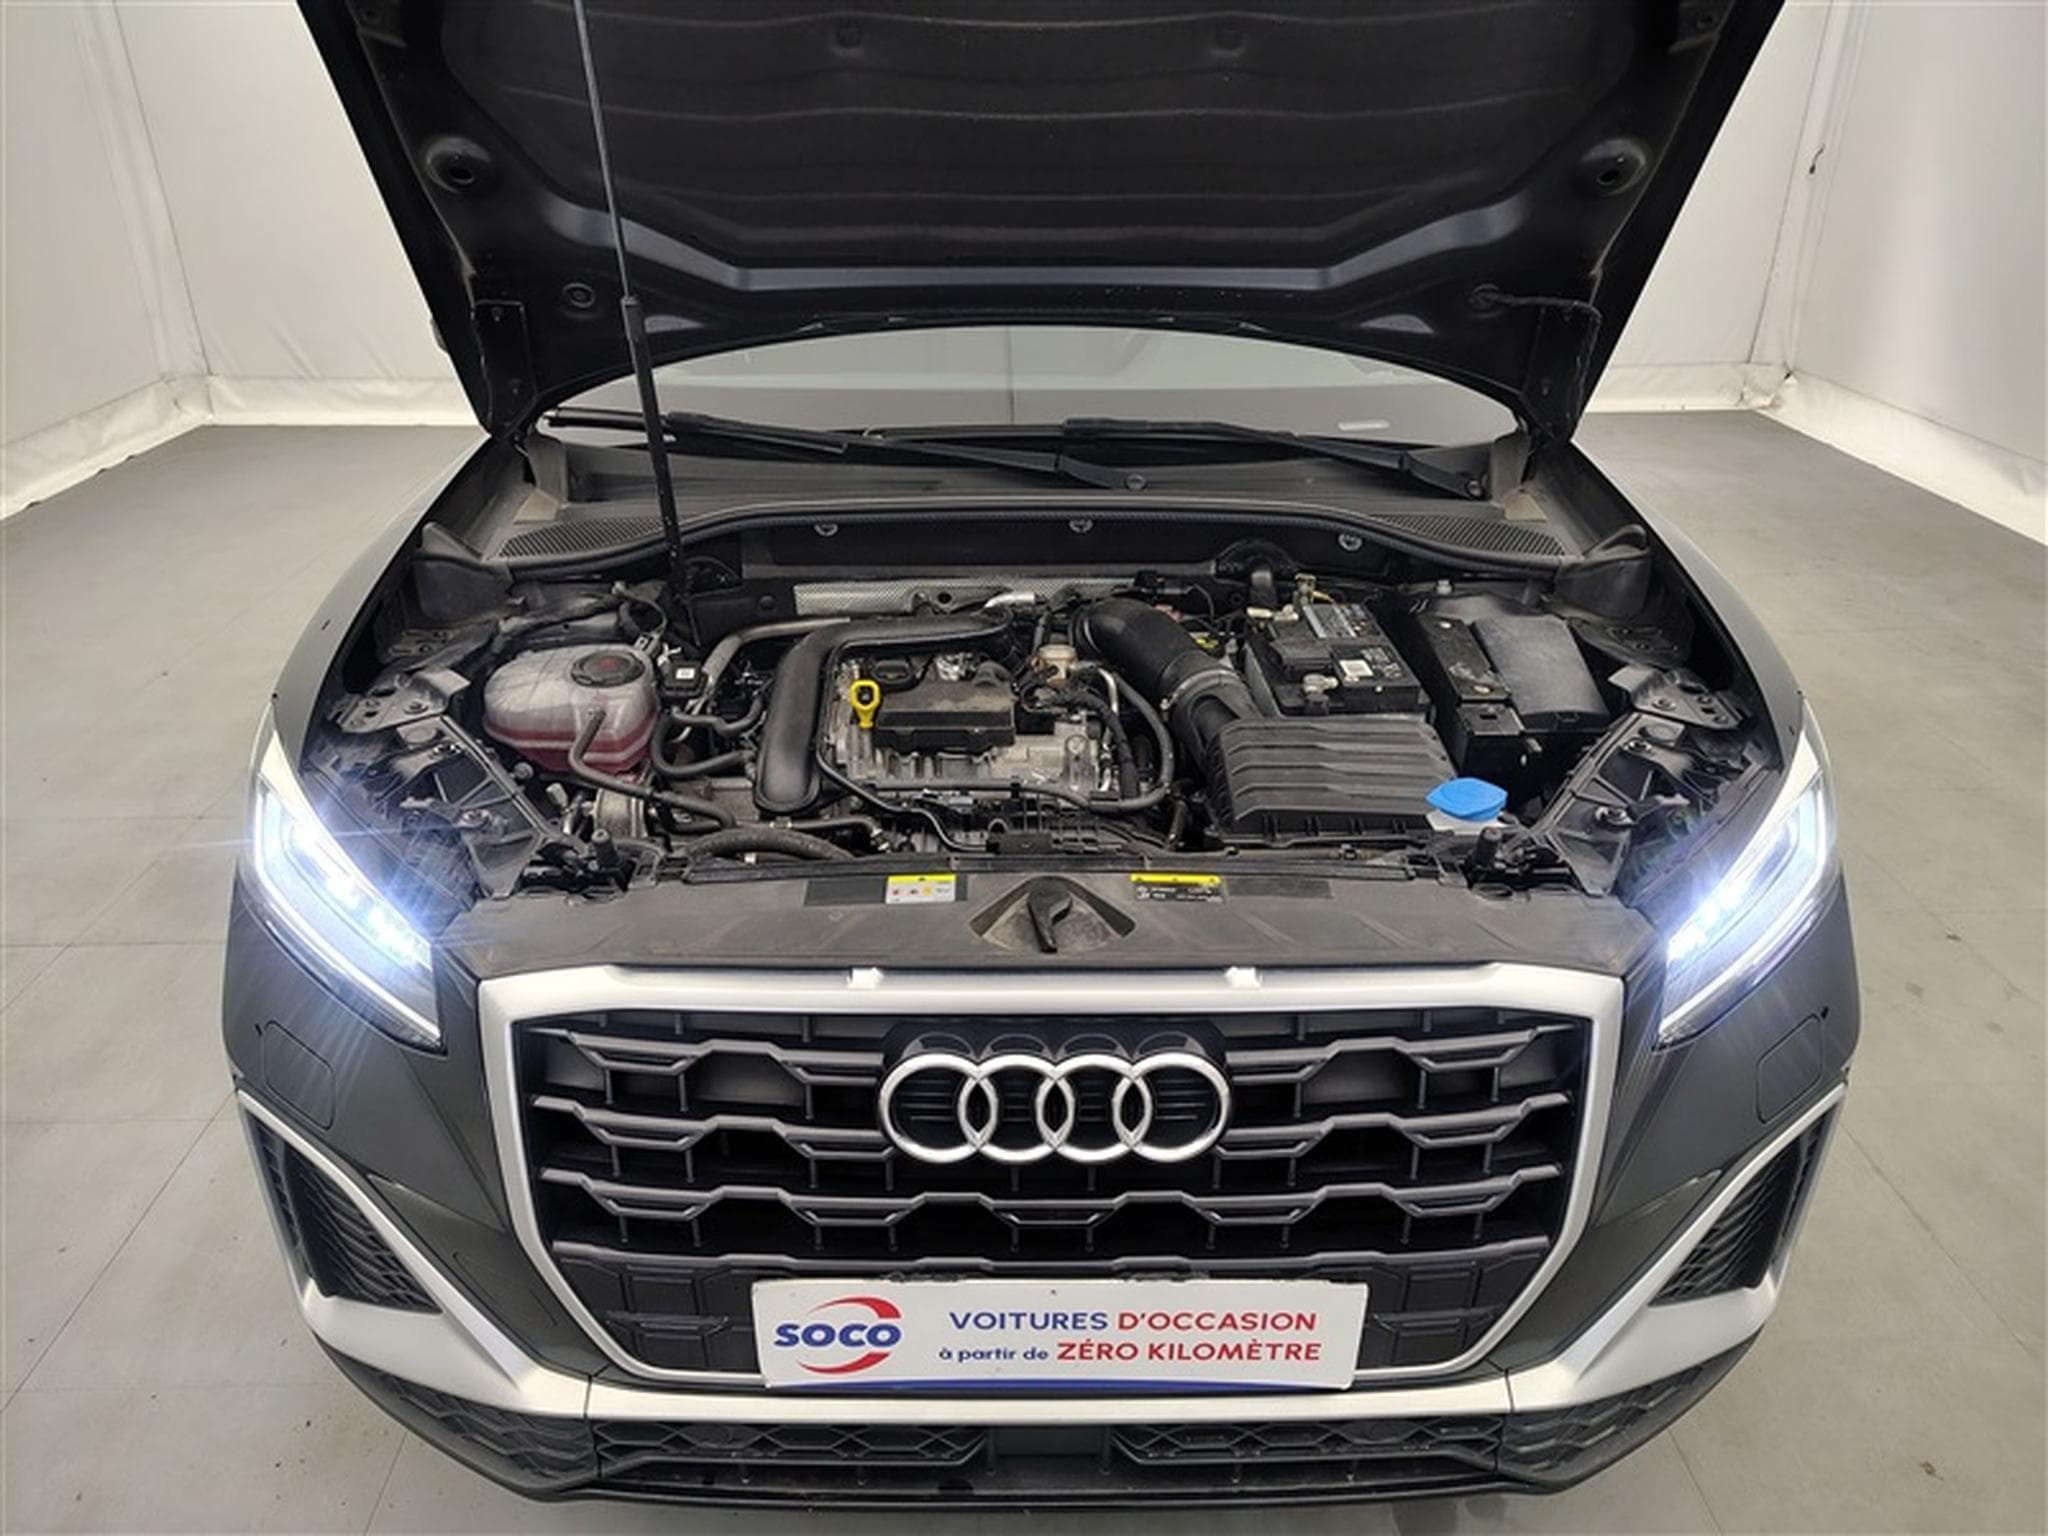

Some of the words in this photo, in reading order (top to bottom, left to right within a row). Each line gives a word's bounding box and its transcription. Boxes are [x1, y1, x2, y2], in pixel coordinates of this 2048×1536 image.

[950, 1311, 1108, 1330] VOITURES
[1118, 1311, 1317, 1331] D'OCCASION
[774, 1323, 901, 1347] SOCO
[939, 1346, 952, 1360] à
[958, 1346, 1016, 1363] partir
[1023, 1346, 1049, 1360] de
[1057, 1338, 1138, 1361] ZÉRO
[1148, 1338, 1322, 1361] KILOMÈTRE
